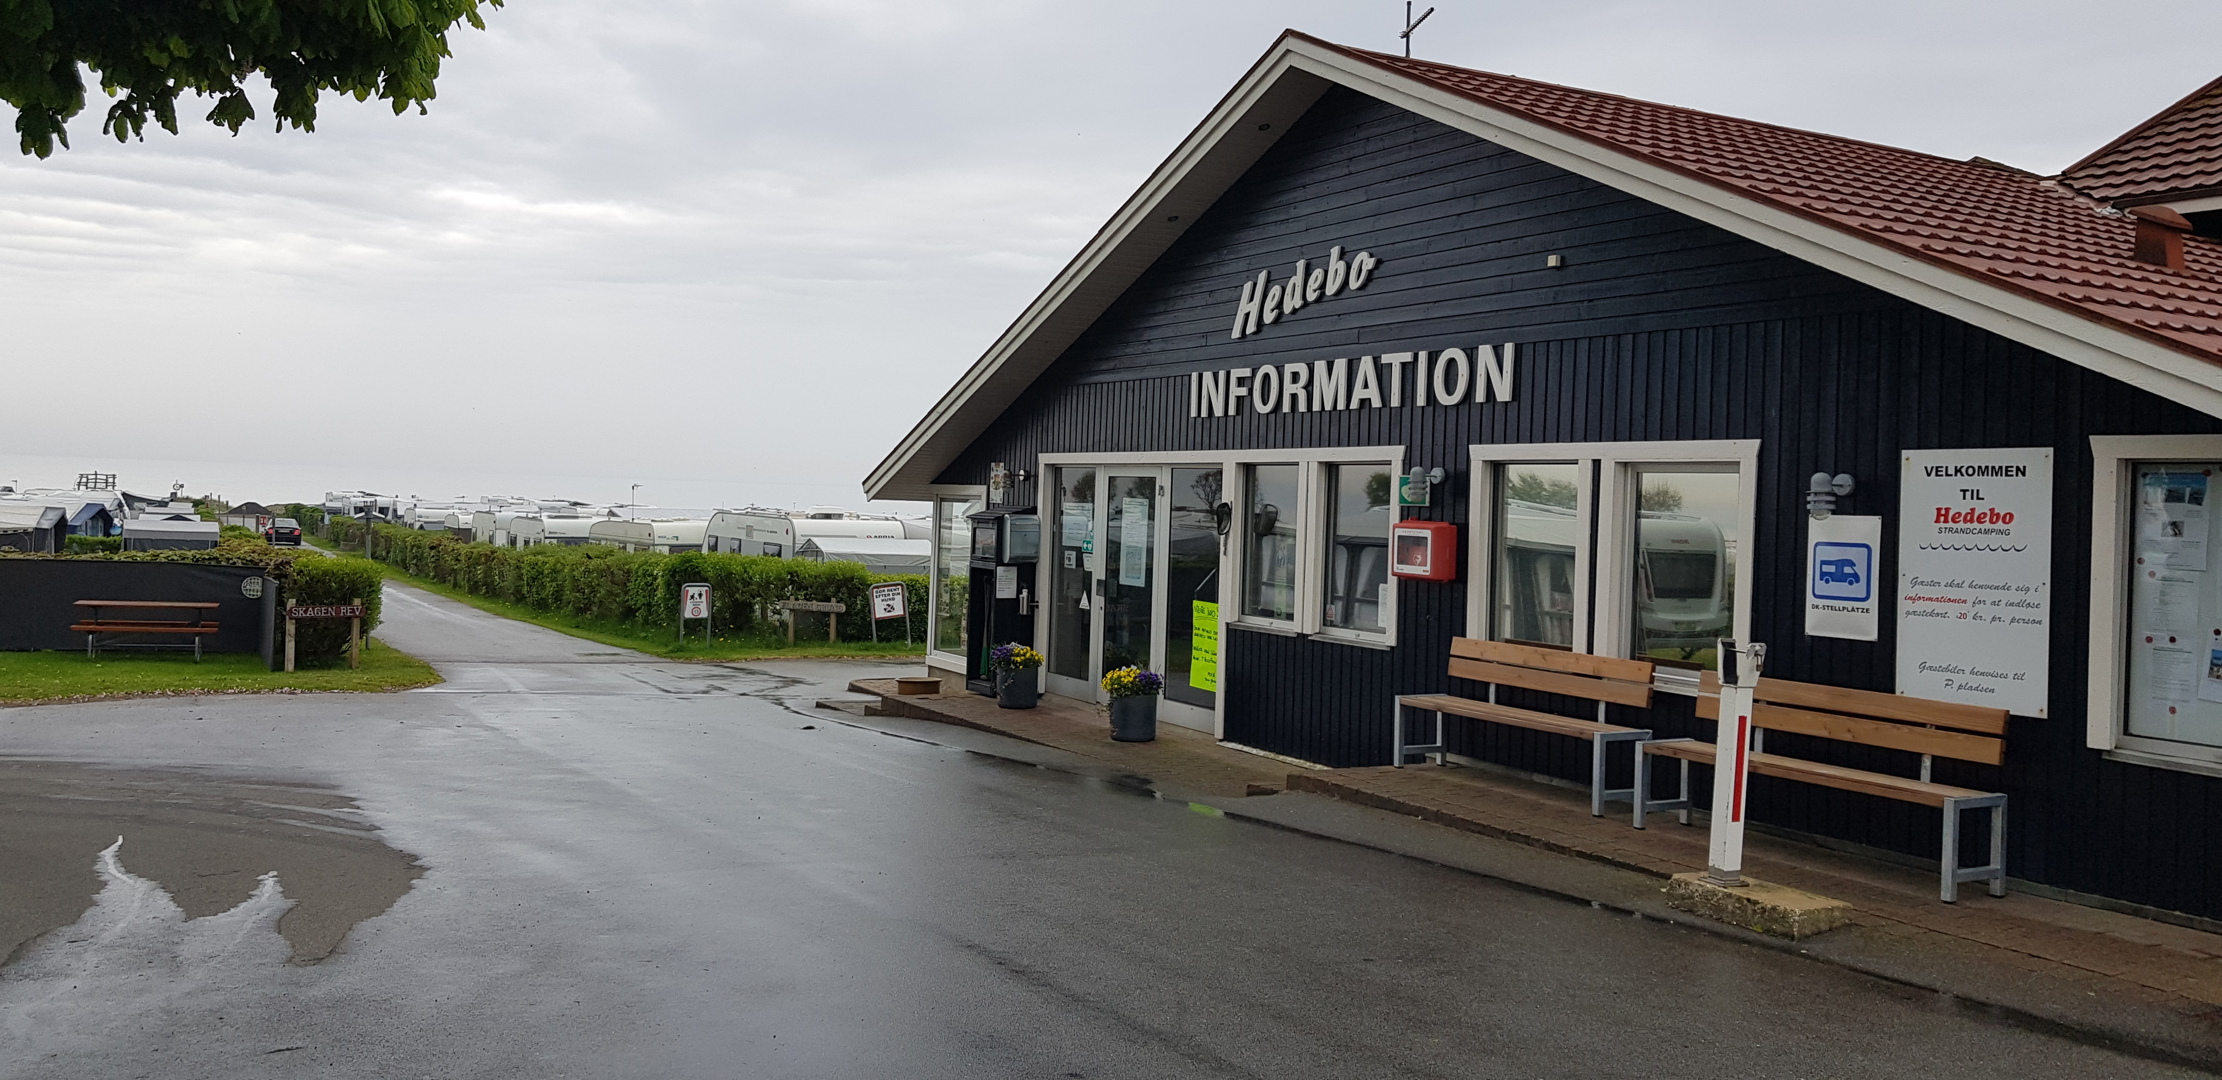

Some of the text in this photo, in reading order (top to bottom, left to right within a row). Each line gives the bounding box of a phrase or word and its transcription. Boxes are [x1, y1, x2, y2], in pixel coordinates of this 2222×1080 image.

[1230, 245, 1378, 339] Hedebo
[1189, 342, 1516, 418] INFORMATION
[1924, 465, 2027, 477] VELKOMMEN
[1959, 489, 1985, 500] TIL
[1933, 507, 2015, 525] Hedebo
[1937, 527, 2011, 536] STRANDCAMPING
[1909, 576, 1942, 589] Gæster
[1943, 578, 1965, 589] skal
[1967, 580, 2012, 592] henvende
[2014, 582, 2031, 595] sig
[1904, 593, 2042, 609] informationen for at indløse
[291, 606, 362, 617] SKAGEN REV
[1904, 608, 1950, 619] gæstekort.
[1971, 611, 1987, 622] kr.
[1989, 614, 2005, 625] pr.
[2008, 616, 2043, 626] person
[1918, 660, 2026, 681] Gæstebiler henvises til
[1943, 678, 1997, 694] P. pladsen
